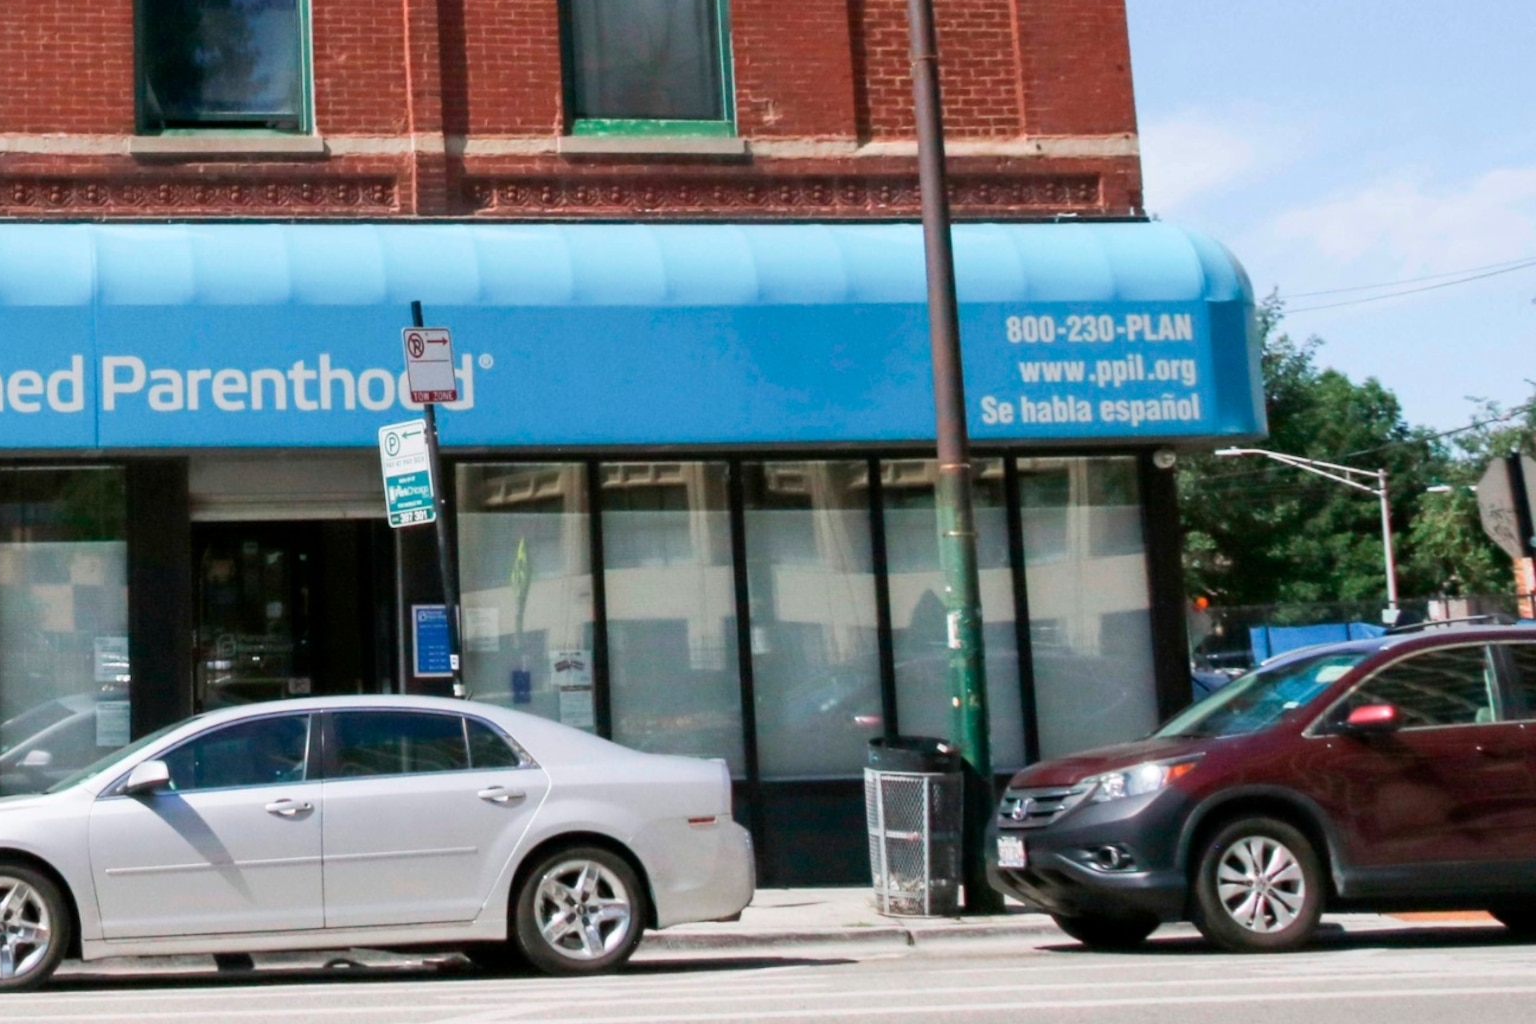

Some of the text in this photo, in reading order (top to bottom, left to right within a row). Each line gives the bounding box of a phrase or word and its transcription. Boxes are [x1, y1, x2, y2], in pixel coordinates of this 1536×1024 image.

[1005, 313, 1193, 343] 800-230-PLAN
[1019, 354, 1197, 387] www.ppil.org
[432, 390, 454, 401] ZONE
[981, 392, 1201, 427] Se habla español
